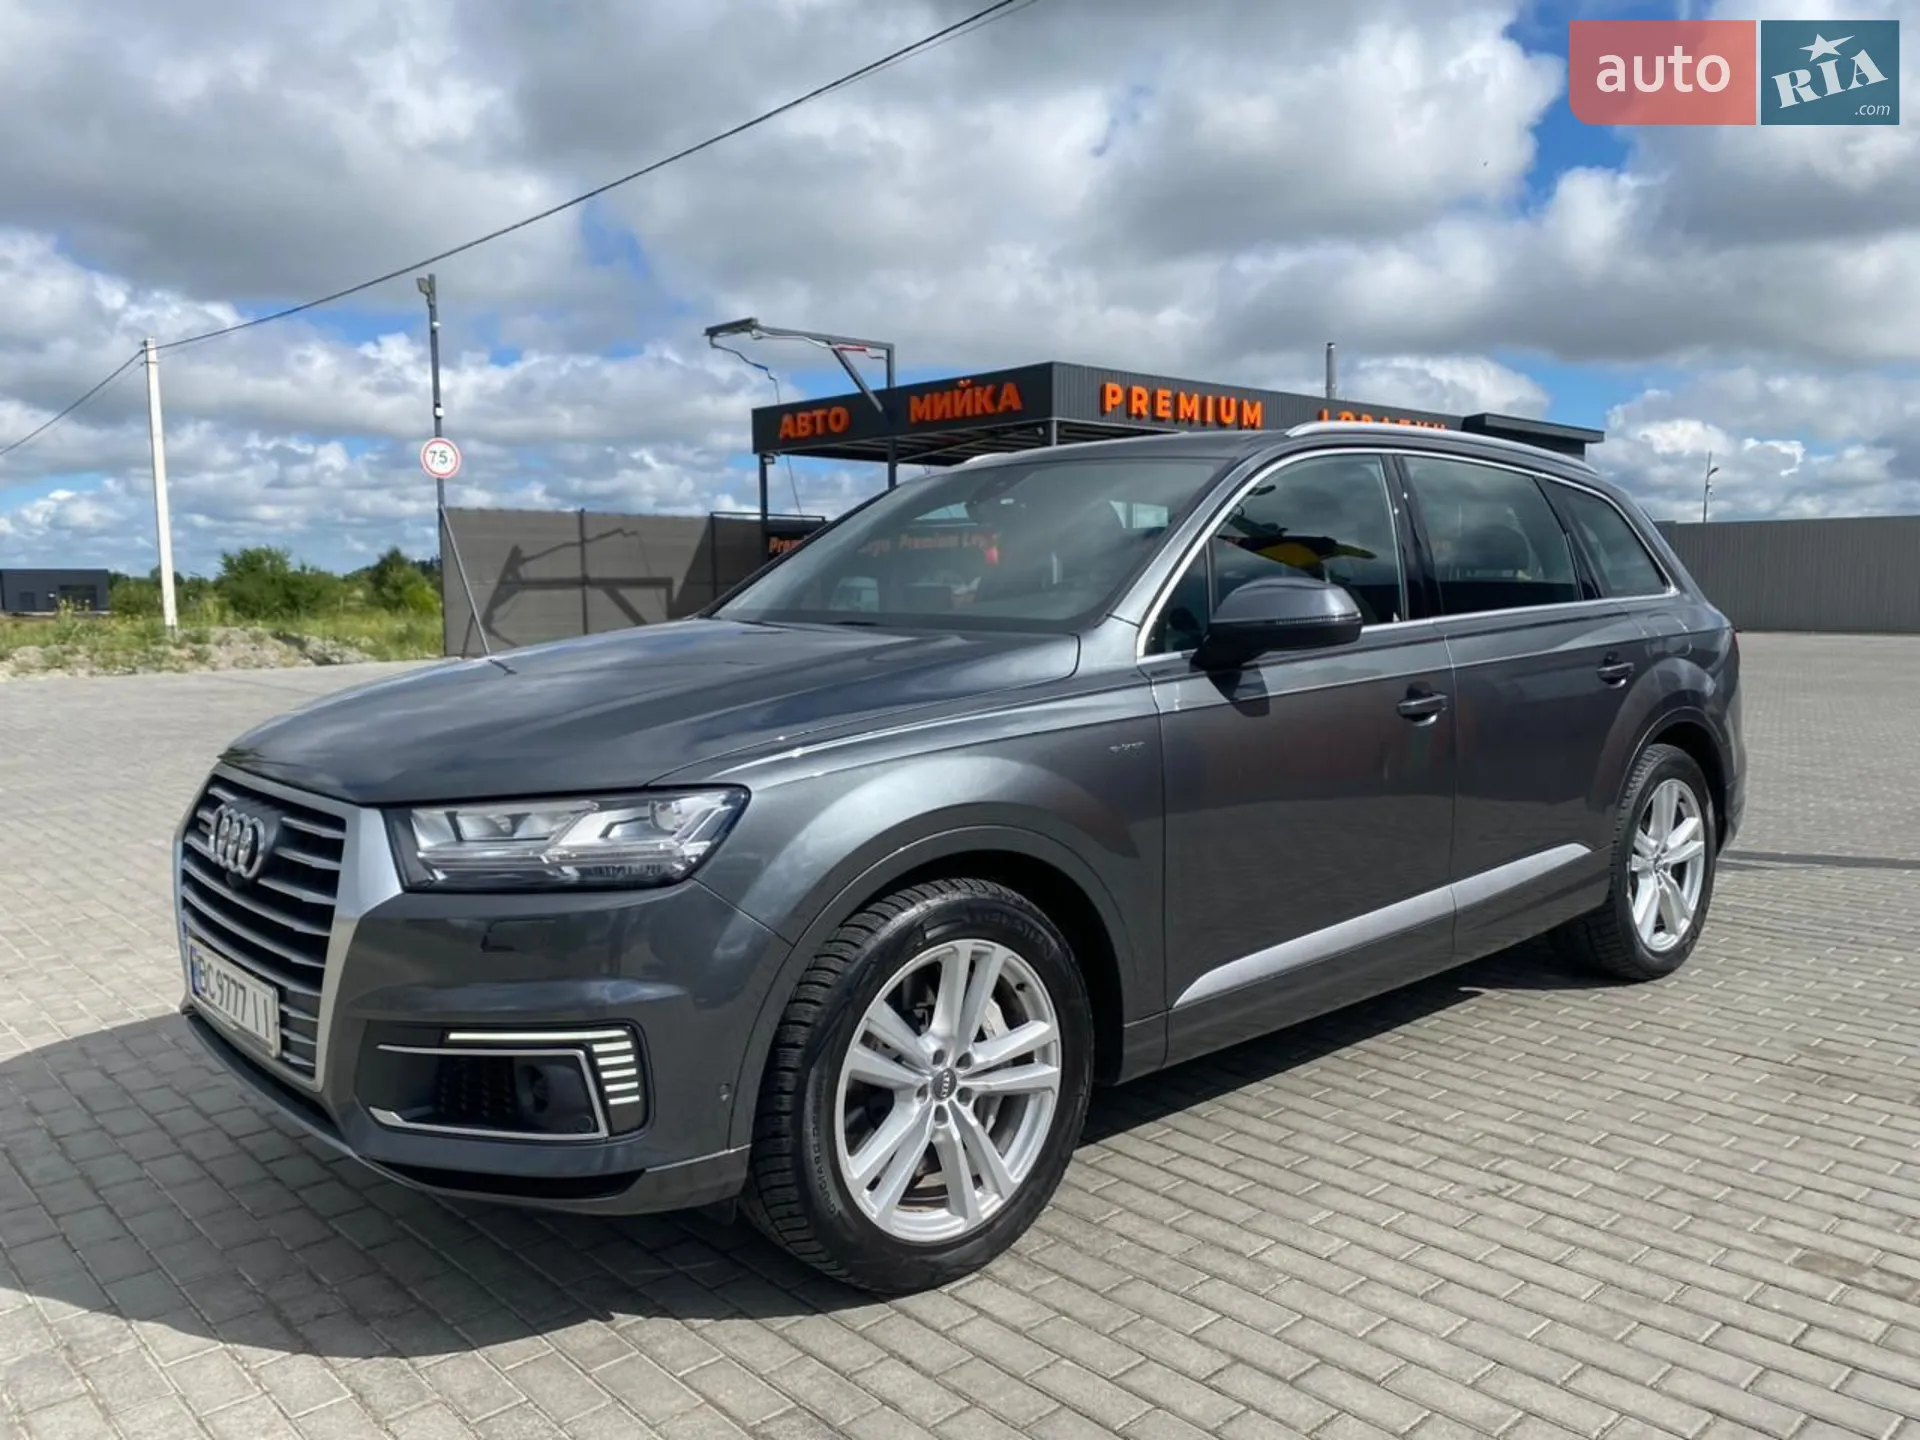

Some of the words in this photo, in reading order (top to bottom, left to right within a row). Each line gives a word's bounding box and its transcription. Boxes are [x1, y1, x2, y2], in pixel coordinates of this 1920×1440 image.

[778, 406, 851, 441] АВТО
[909, 379, 1023, 423] МИЙКА
[1102, 381, 1265, 430] PREMIUM
